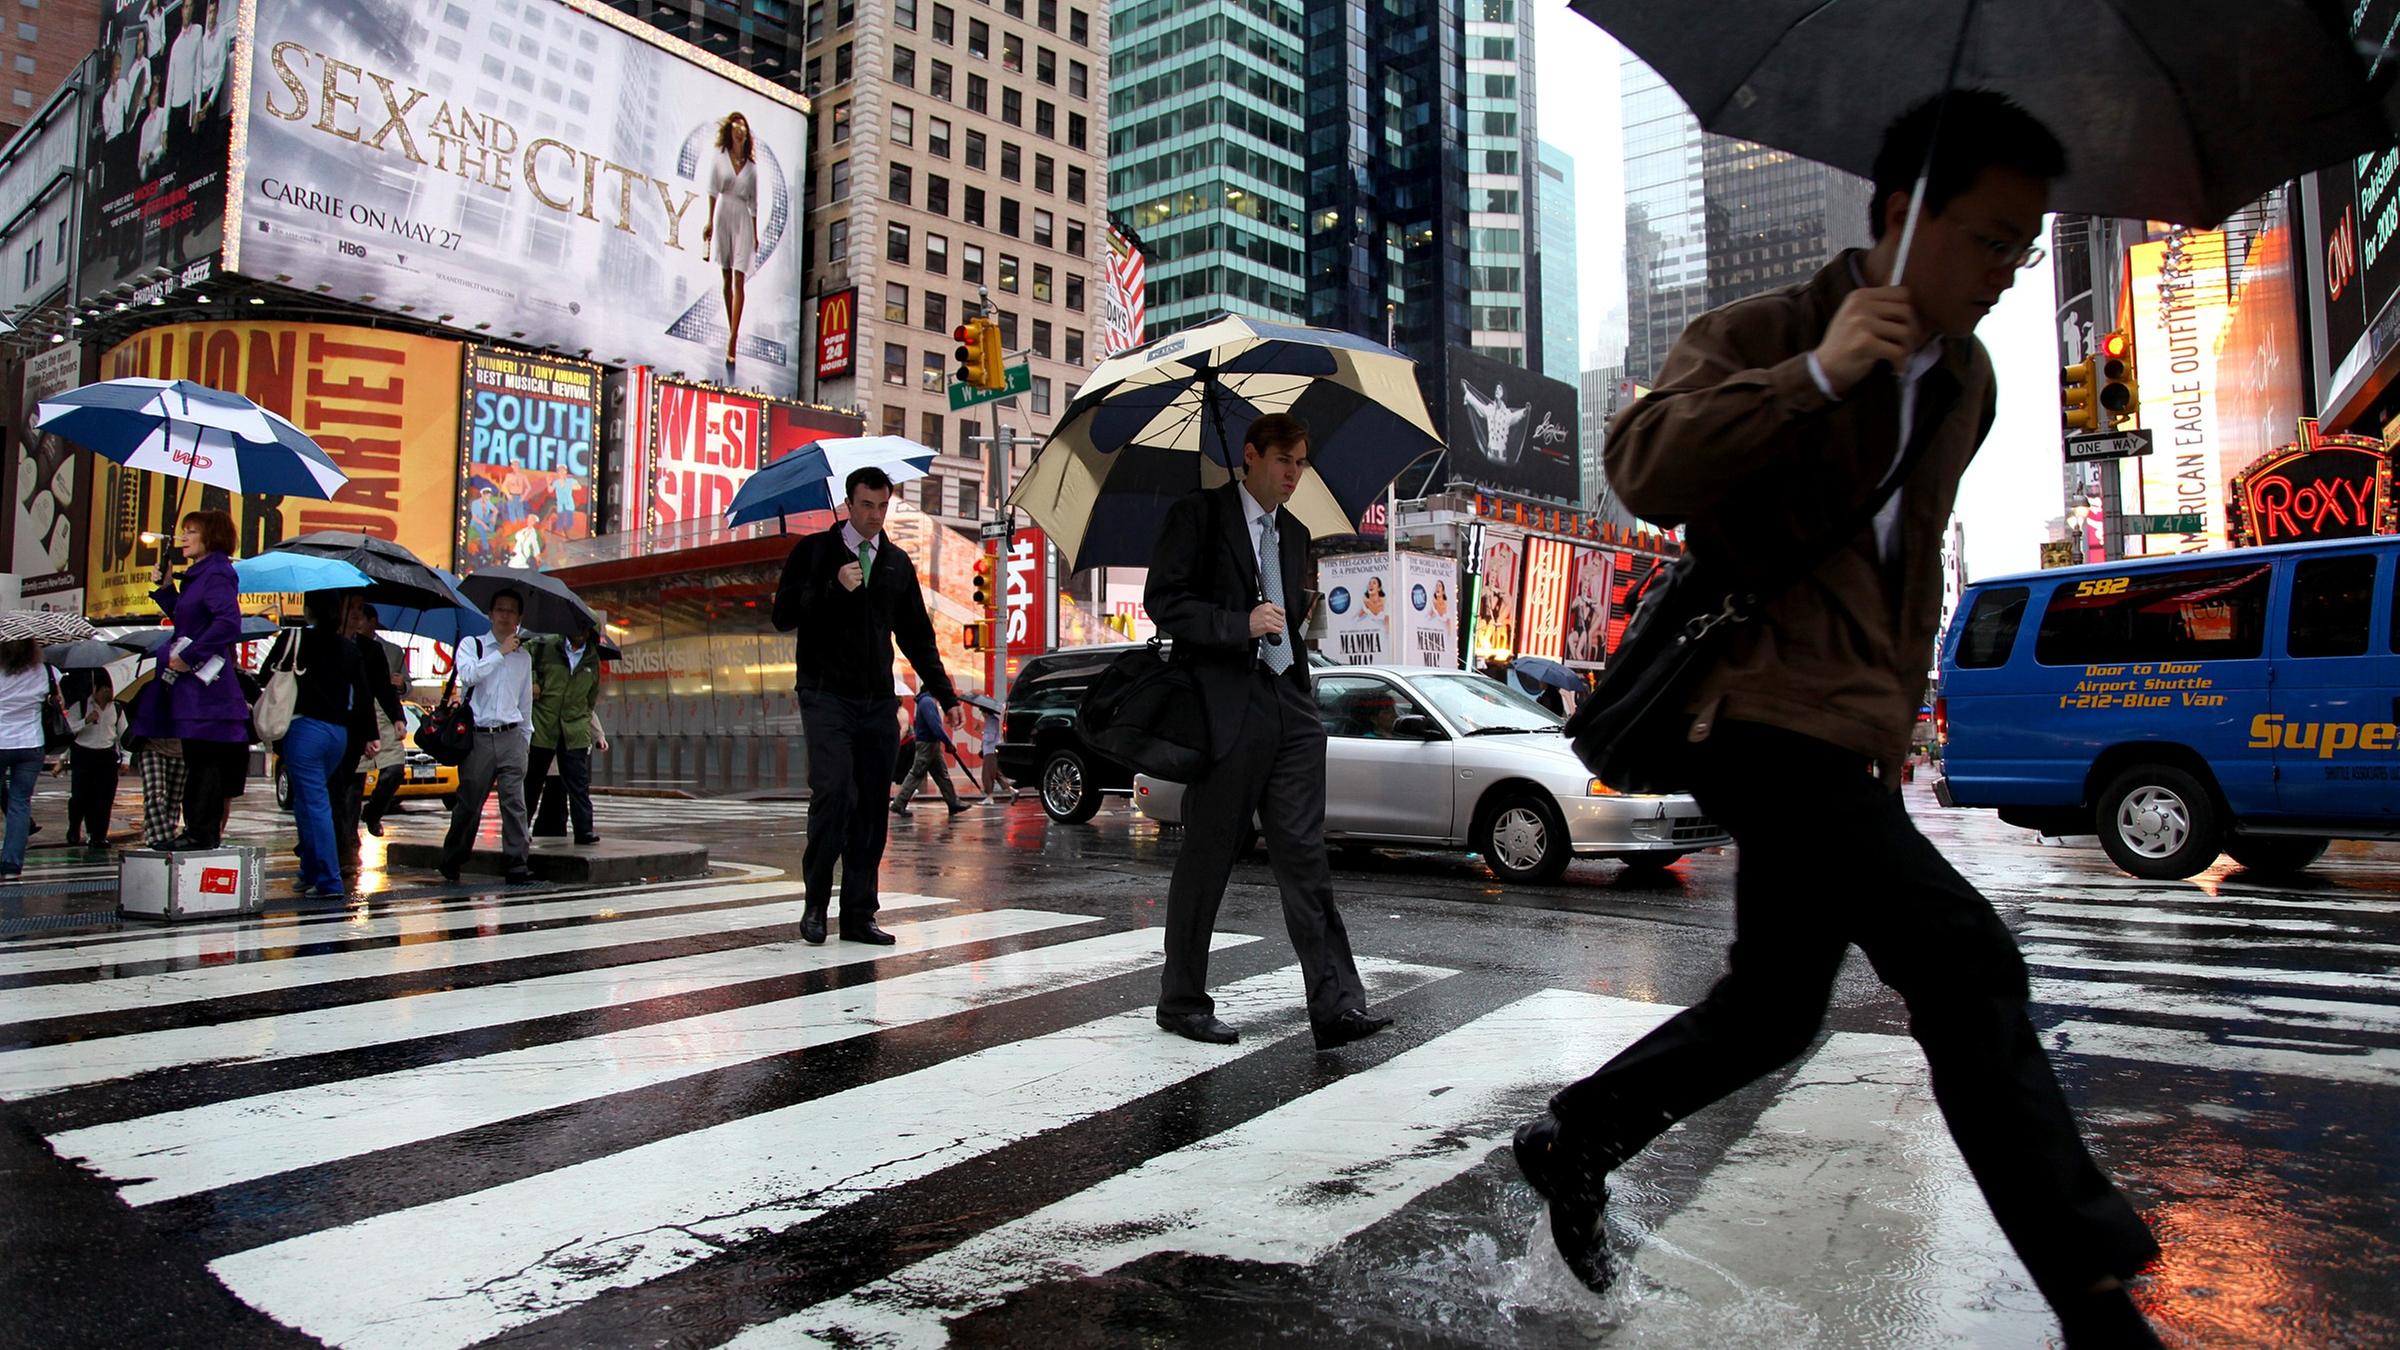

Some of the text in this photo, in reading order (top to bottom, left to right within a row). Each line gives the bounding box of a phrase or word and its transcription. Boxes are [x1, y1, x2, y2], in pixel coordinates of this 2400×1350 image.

[261, 178, 463, 252] CARRIE ON MAY 27
[265, 41, 789, 366] SEX AND THE CITY 2
[2364, 195, 2399, 270] for 2008
[338, 239, 367, 258] HBO
[2328, 203, 2356, 301] CNN
[181, 262, 211, 289] starz
[133, 280, 163, 308] FRIDAYS
[824, 333, 846, 346] OPEN
[826, 343, 843, 360] 24
[476, 355, 591, 386] WINNER! 7 TONY AWARDS
[821, 357, 848, 372] HOURS
[476, 369, 503, 386] BEST
[504, 373, 550, 395] MUSICAL
[552, 381, 591, 401] REVIVAL
[961, 386, 973, 402] W
[474, 390, 591, 441] SOUTH
[2172, 380, 2204, 446] EAGLE
[658, 384, 760, 471] WEST
[472, 425, 589, 477] PACIFIC
[2076, 438, 2139, 454] ONE WAY
[655, 464, 747, 550] SID
[2144, 515, 2199, 532] W 47 ST
[246, 592, 277, 605] Street
[1007, 538, 1034, 643] tkts
[2075, 577, 2130, 598] 582
[1340, 632, 1382, 655] MAMMA
[1416, 630, 1446, 652] MAMMA
[1423, 651, 1441, 668] MIA!
[2085, 661, 2203, 678] Door to Door
[2074, 677, 2213, 694] Airport Shuttle
[2059, 692, 2225, 709] 1-212-Blue Van
[2248, 713, 2400, 759] Supe
